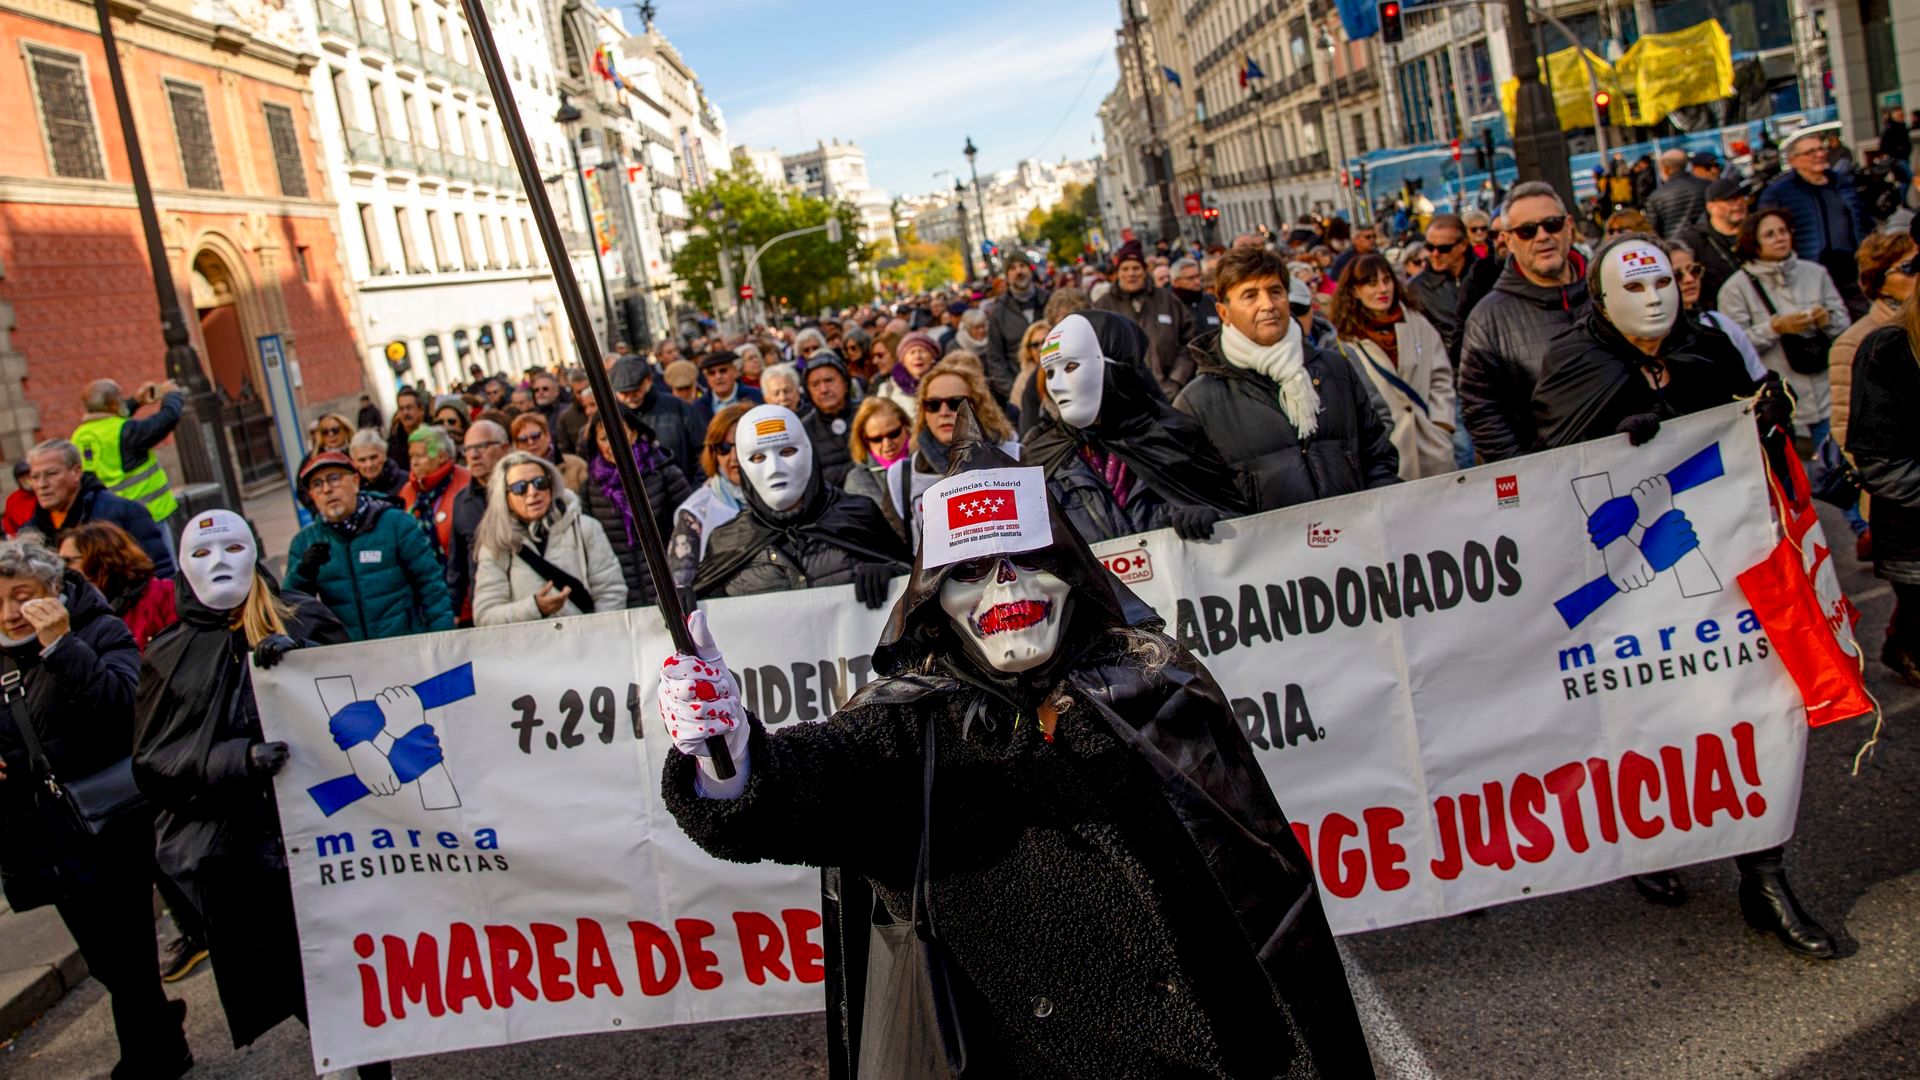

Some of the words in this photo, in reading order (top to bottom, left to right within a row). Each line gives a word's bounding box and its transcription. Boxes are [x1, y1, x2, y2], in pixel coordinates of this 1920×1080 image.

[940, 481, 983, 498] Residencias
[993, 480, 1021, 488] Madrid
[511, 683, 644, 754] 7.291
[729, 654, 873, 724] IDENT
[1176, 535, 1522, 659] ABANDONADOS
[1559, 607, 1762, 671] marea
[1562, 635, 1769, 700] RESIDENCIAS
[317, 826, 499, 857] marea
[319, 852, 509, 886] RESIDENCIAS
[353, 916, 624, 1028] ¡MAREA
[627, 916, 723, 998] DE
[1430, 721, 1767, 881] JUSTICIA!
